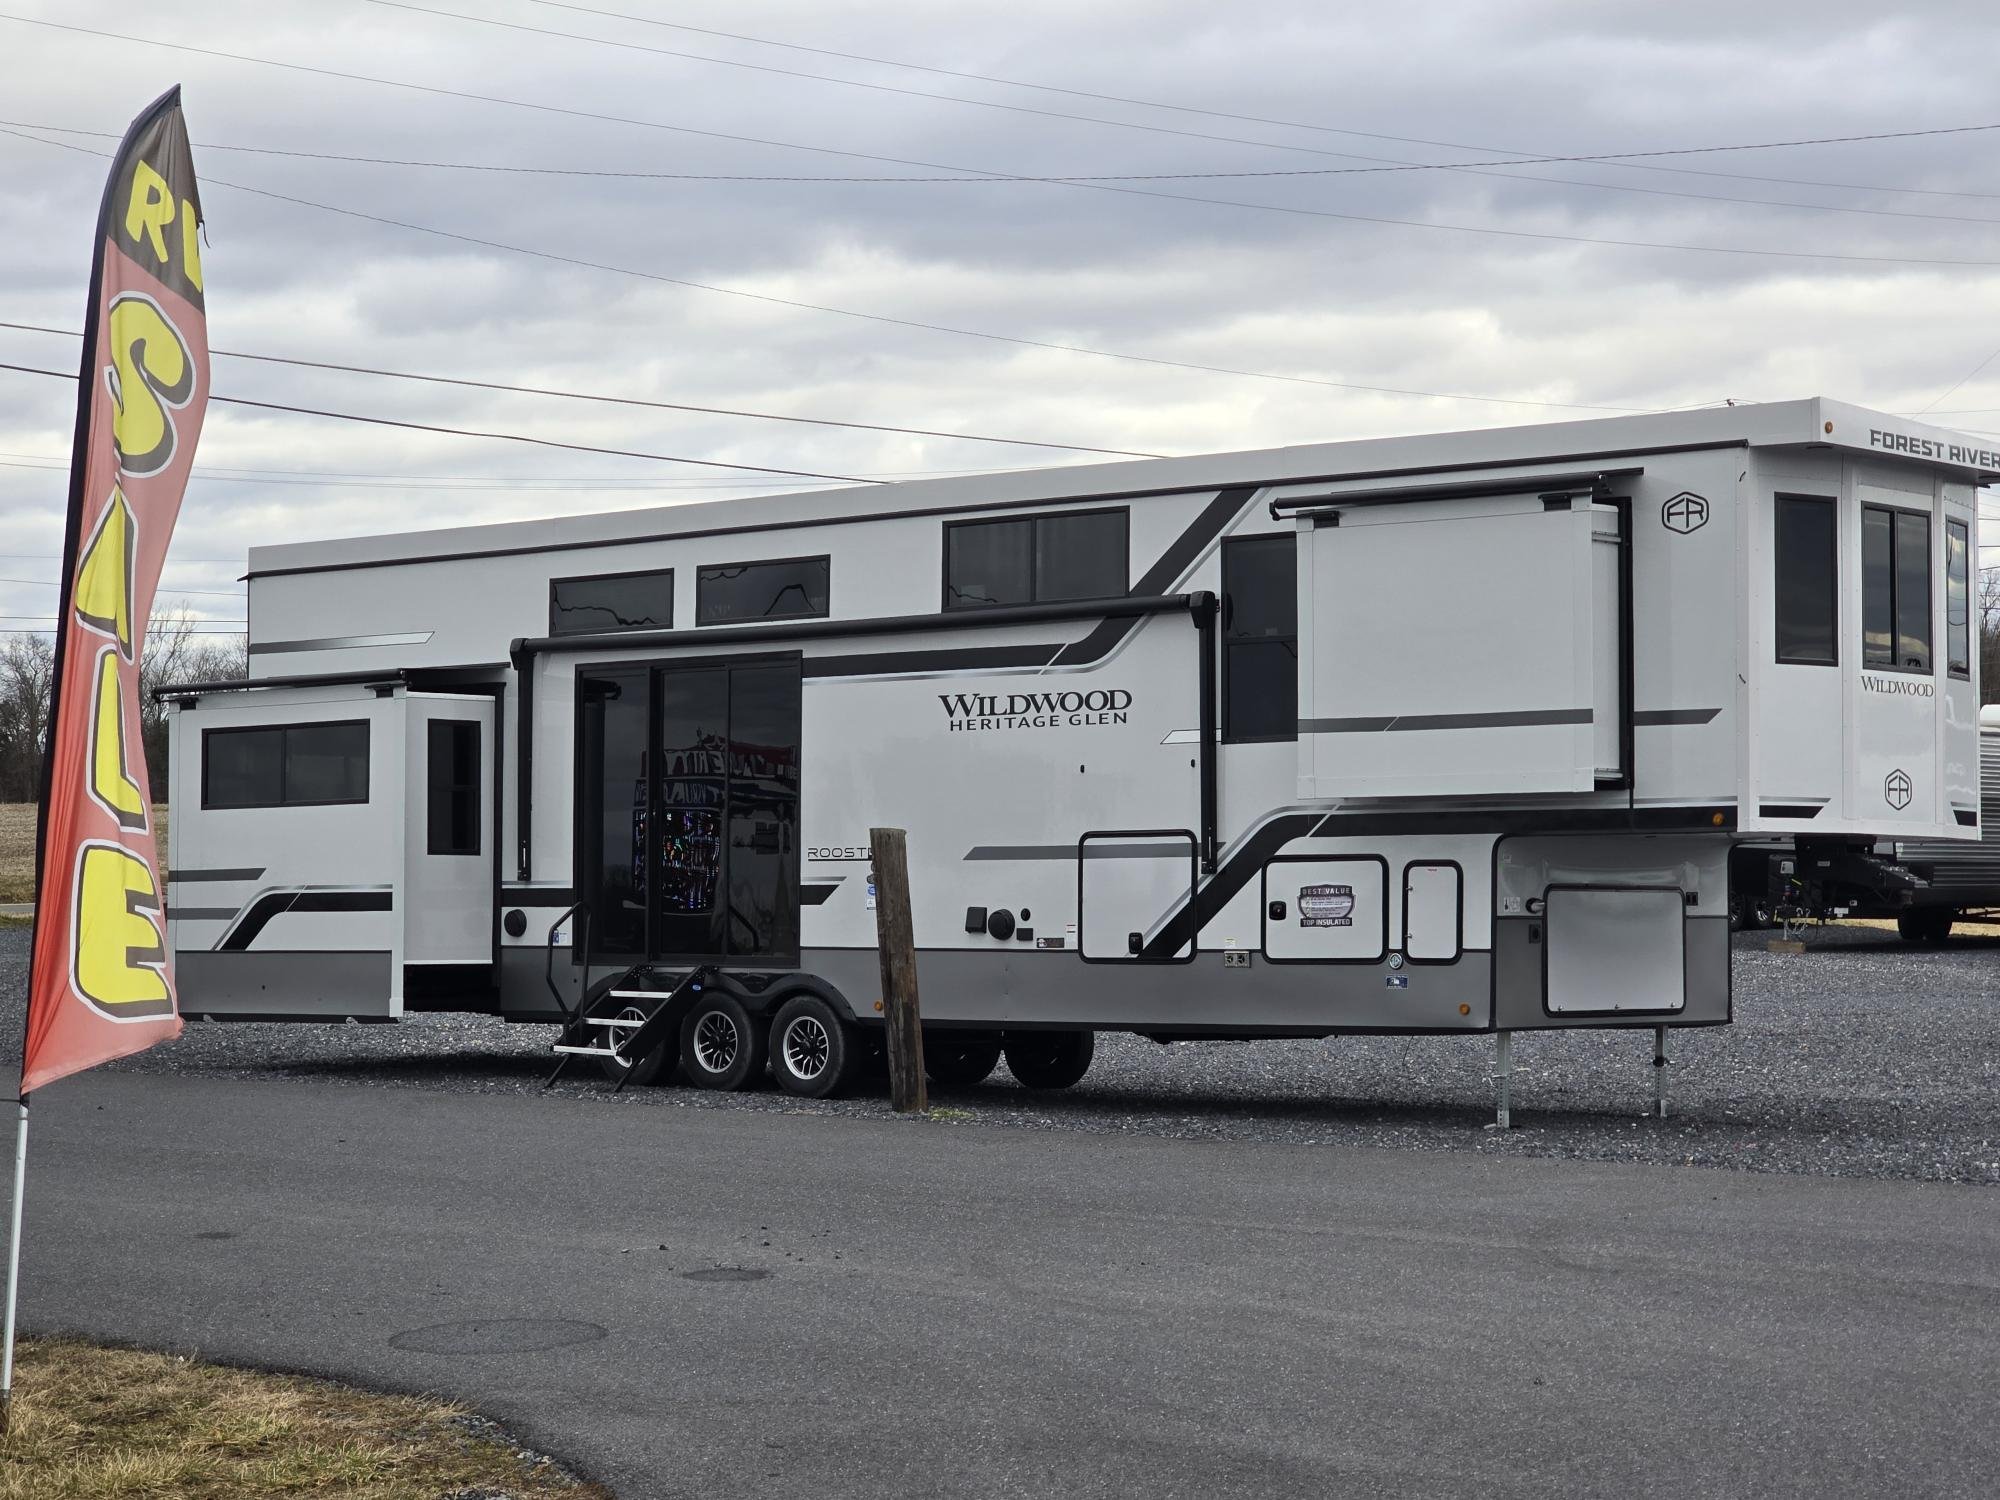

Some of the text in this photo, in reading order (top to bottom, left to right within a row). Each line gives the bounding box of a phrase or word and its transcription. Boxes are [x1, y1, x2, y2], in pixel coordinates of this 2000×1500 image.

[1870, 429, 2000, 468] FOREST RIVER
[949, 712, 1128, 732] HERITAGE GLEN
[1316, 918, 1351, 926] INSULATED
